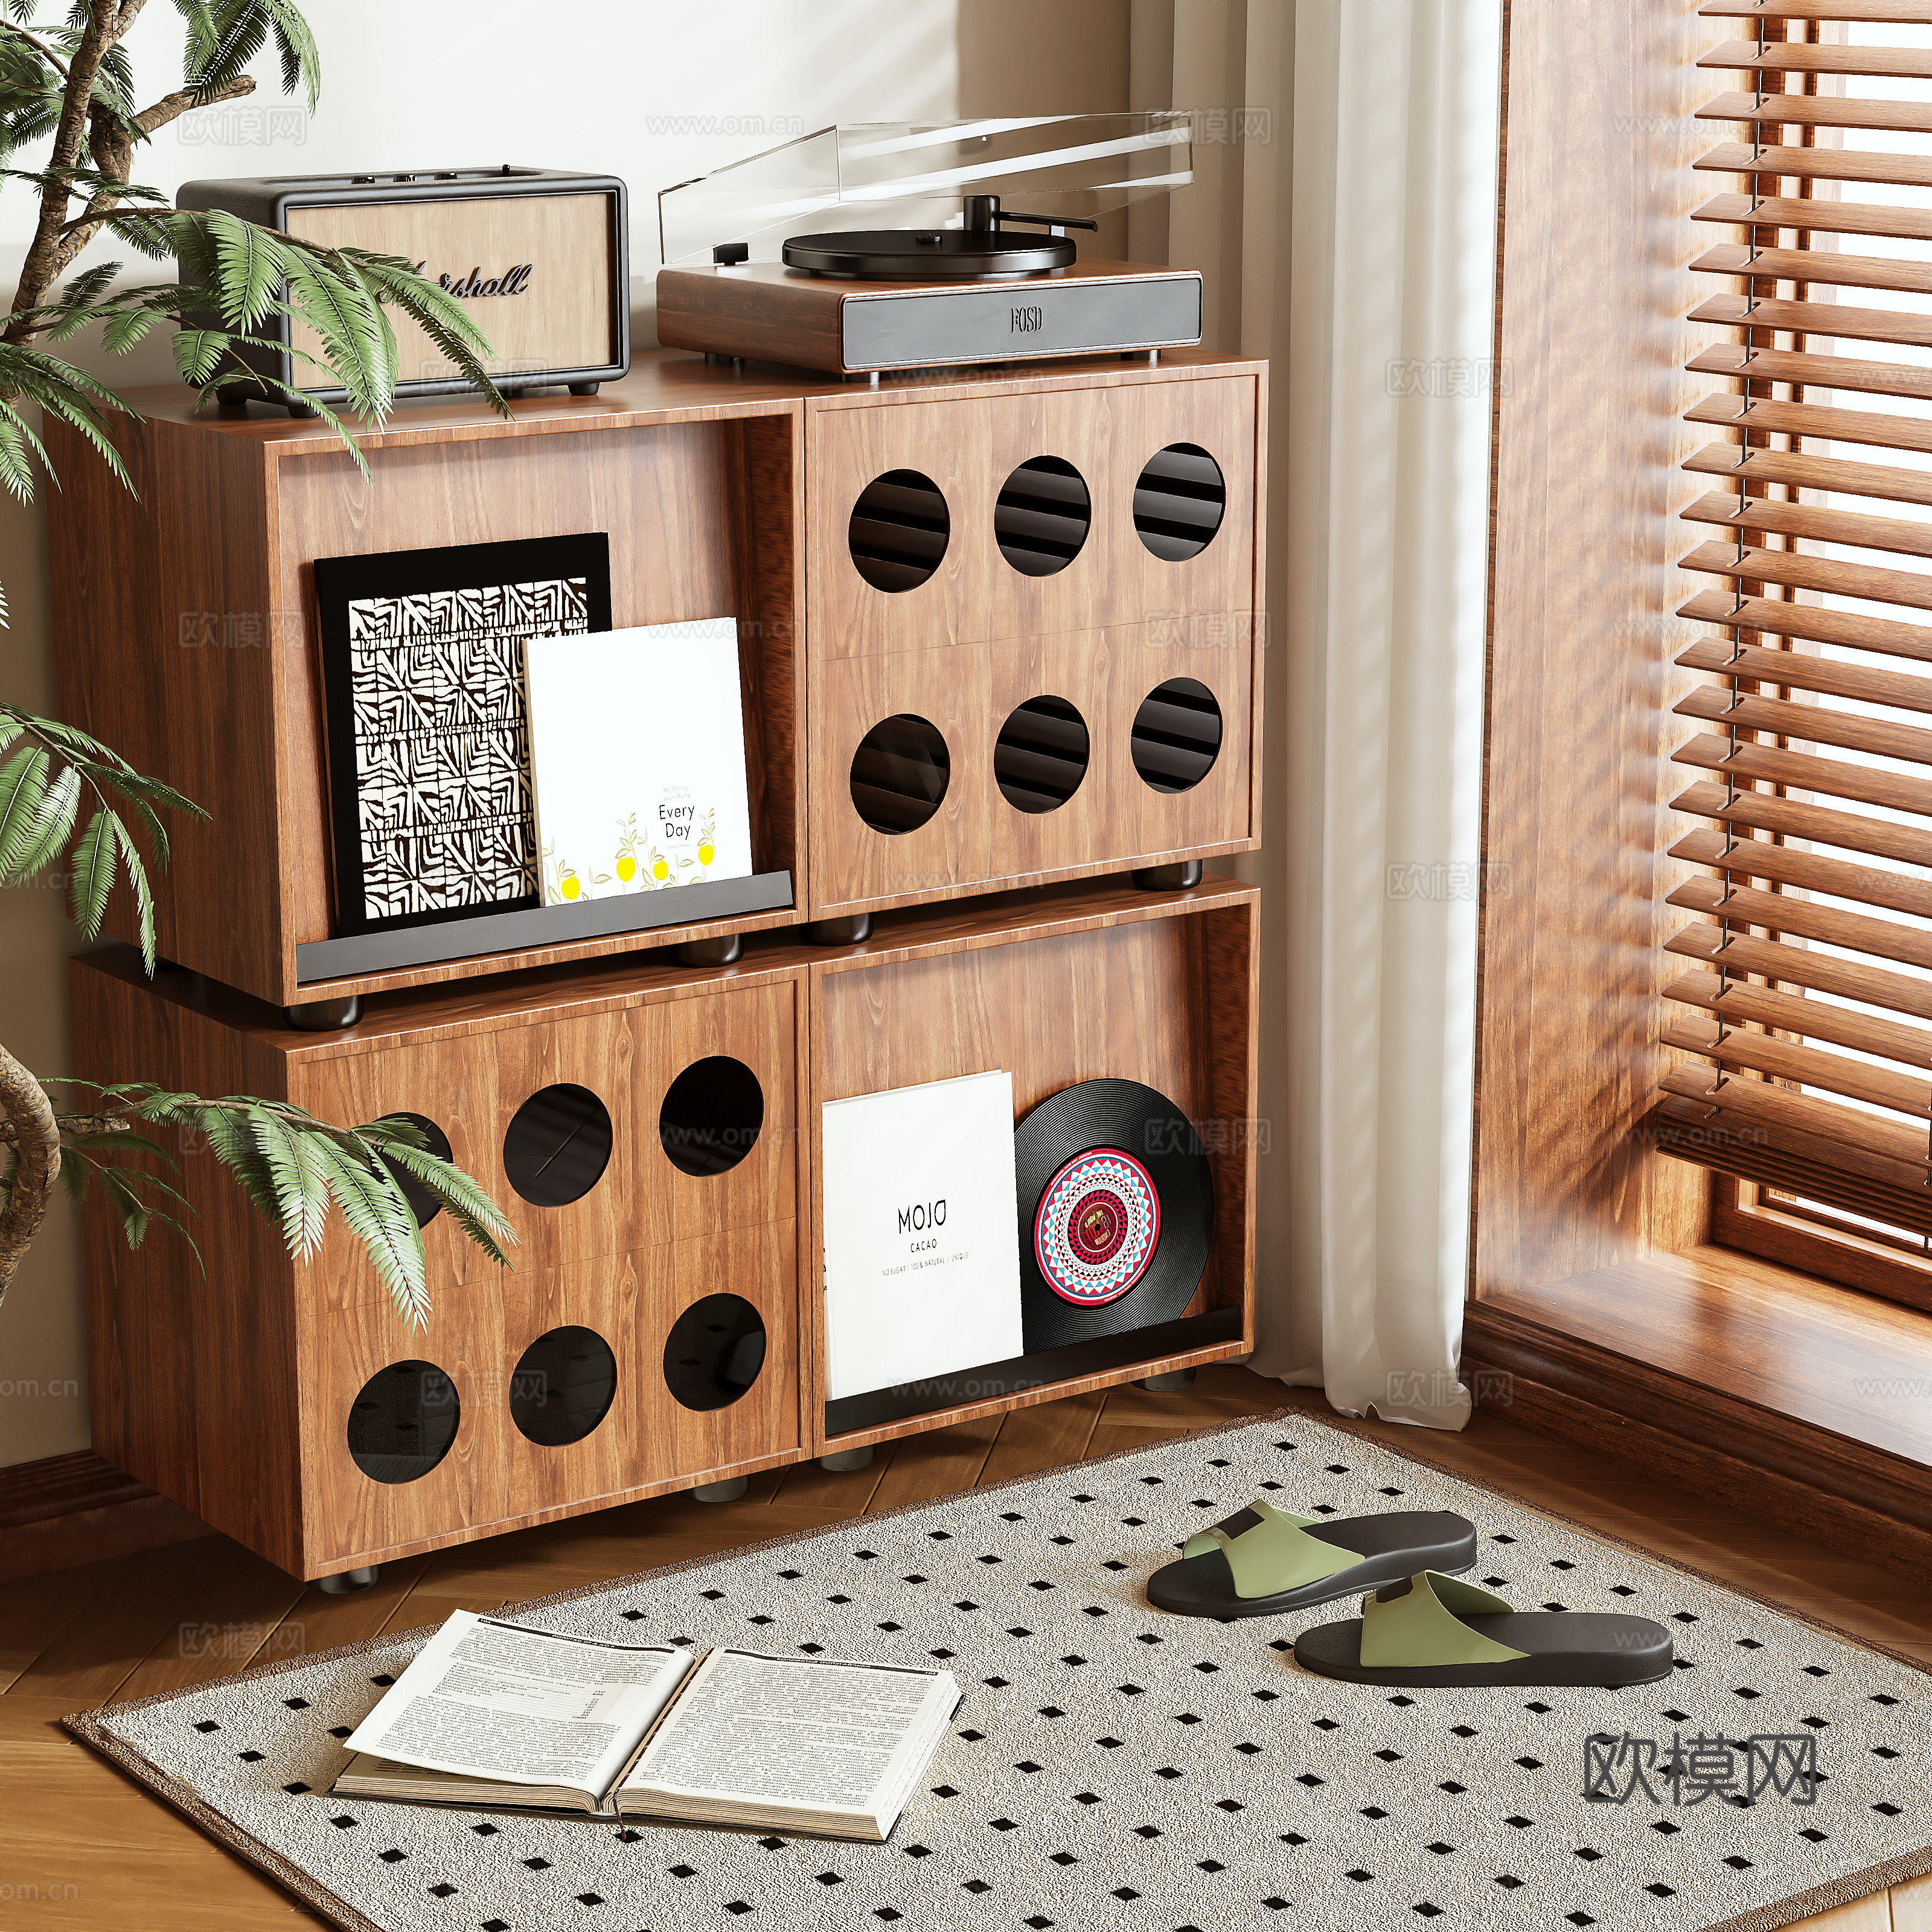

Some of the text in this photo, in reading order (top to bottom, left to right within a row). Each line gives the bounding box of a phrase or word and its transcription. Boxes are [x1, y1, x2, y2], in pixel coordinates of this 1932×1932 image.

[659, 804, 695, 821] Every
[665, 823, 691, 840] Day
[898, 1199, 946, 1234] MOJO
[910, 1238, 937, 1253] CACAO
[924, 1257, 945, 1267] NATURAL
